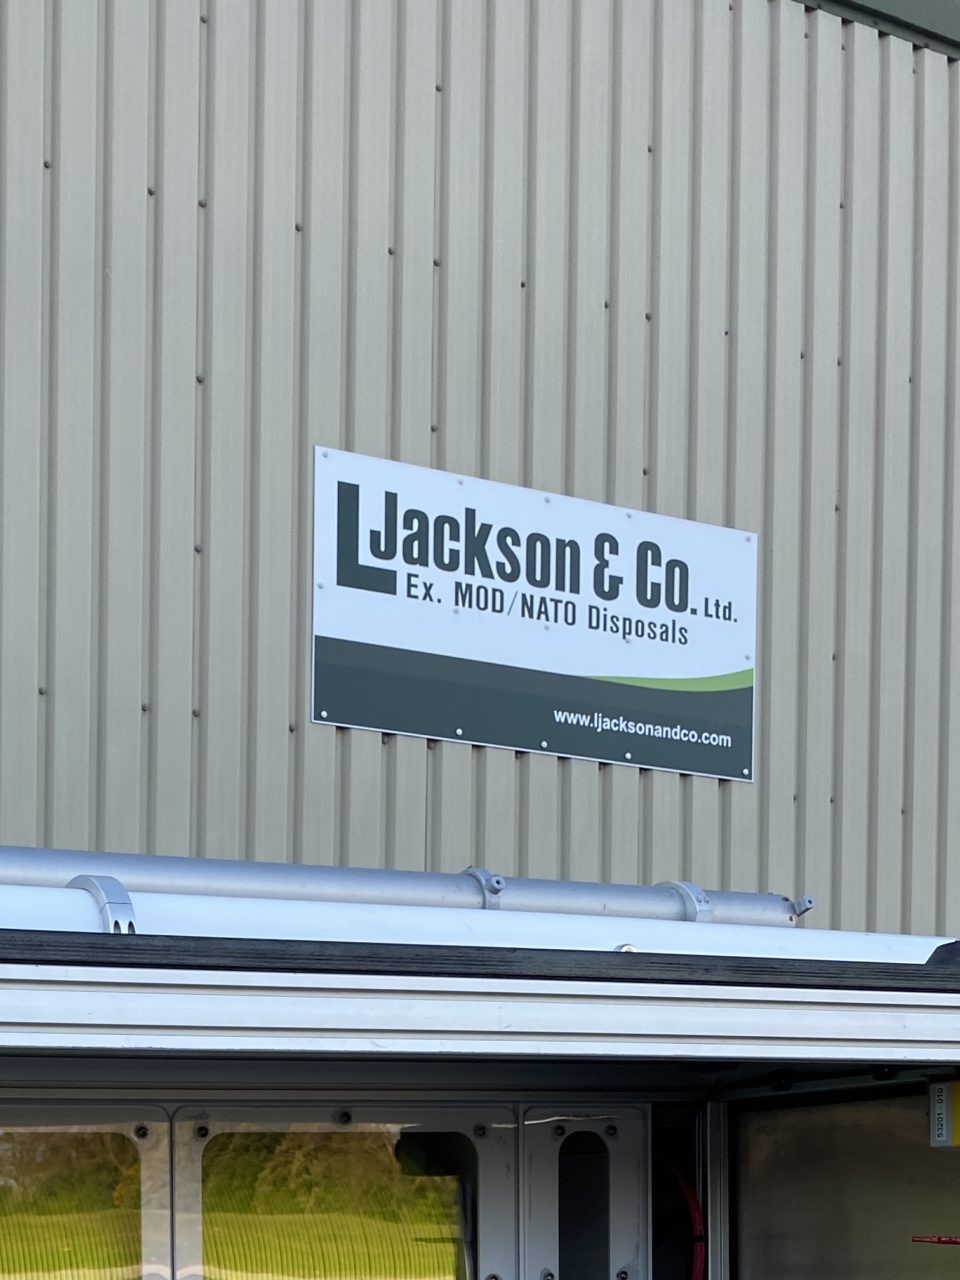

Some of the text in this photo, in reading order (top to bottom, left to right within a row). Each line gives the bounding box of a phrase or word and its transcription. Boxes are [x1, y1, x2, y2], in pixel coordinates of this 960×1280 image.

[406, 573, 689, 646] Ex. MOD/NATO Disposals
[593, 532, 624, 602] &
[636, 540, 698, 616] Co.
[703, 597, 739, 624] Ltd.
[553, 709, 732, 748] www.ljacksonandco.com
